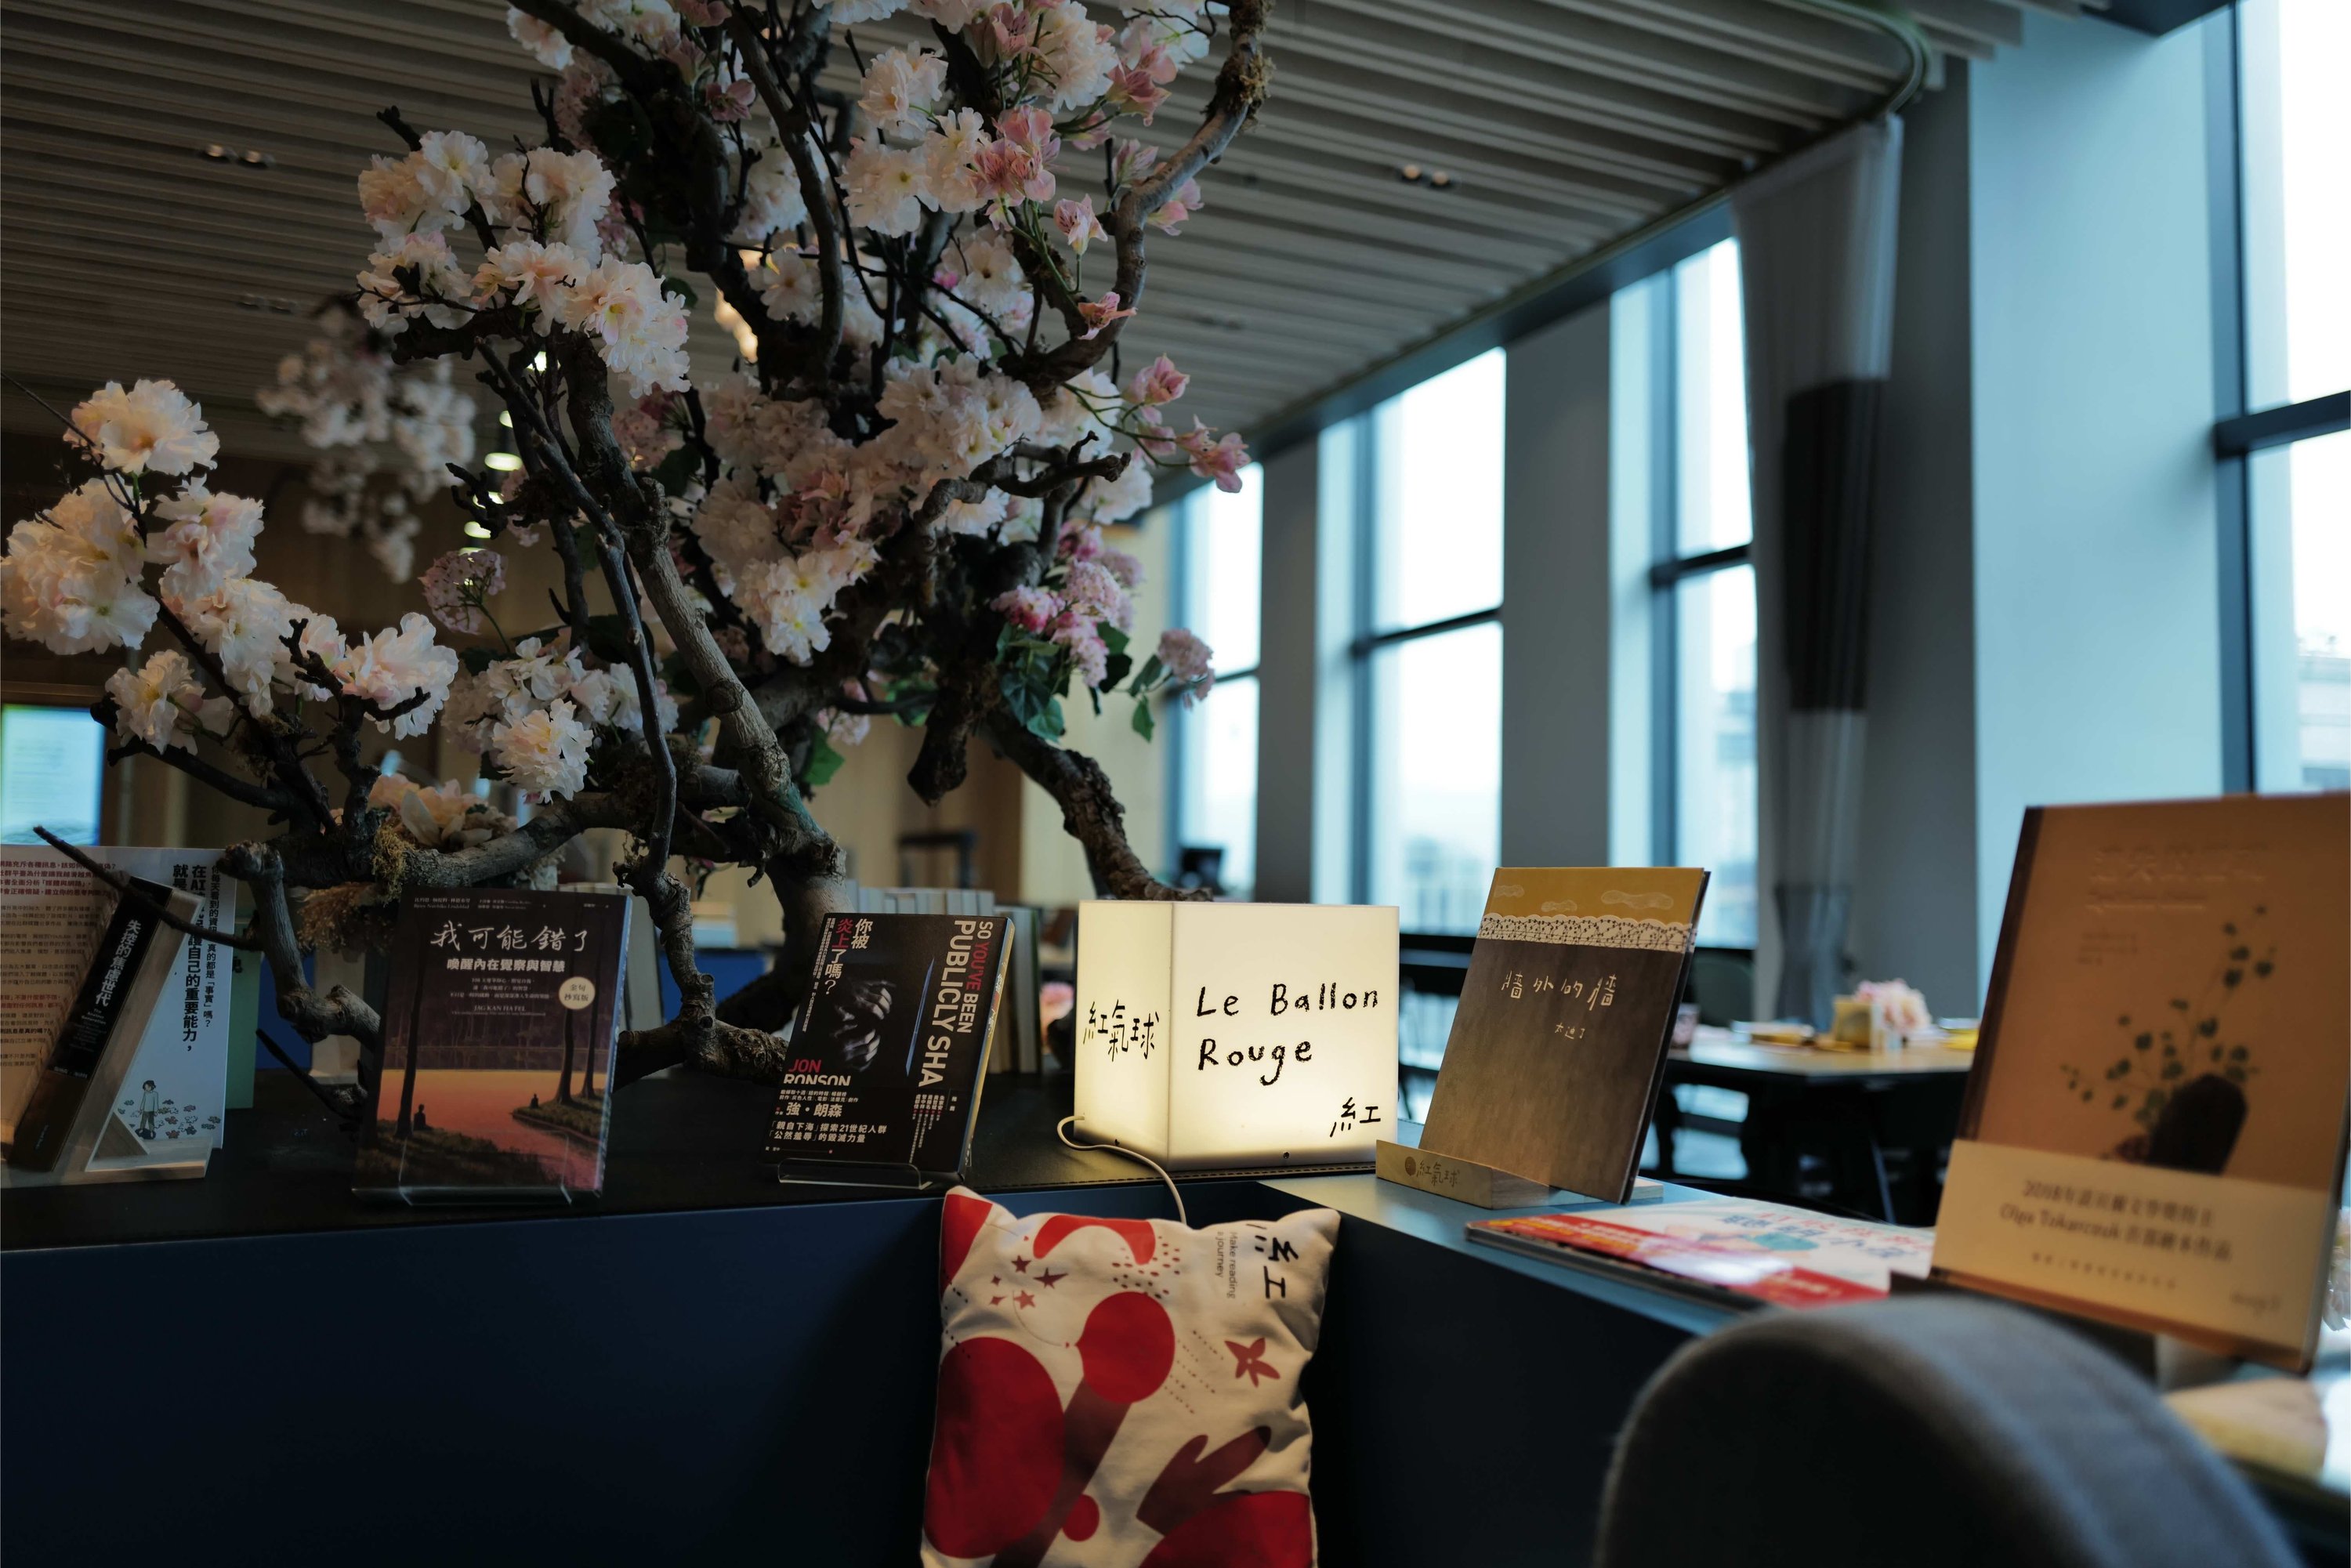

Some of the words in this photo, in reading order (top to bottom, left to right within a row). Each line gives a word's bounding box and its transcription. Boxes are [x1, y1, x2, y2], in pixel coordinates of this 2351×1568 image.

[204, 864, 220, 1027] 你每天看到的資訊真的都是「事實」嗎？
[430, 920, 588, 951] 我可能錯了
[850, 918, 874, 949] 你被
[977, 921, 994, 940] SO
[95, 919, 142, 1008] 失控的焦慮世代
[447, 958, 565, 972] 喚醒內在覺察與智慧
[932, 920, 976, 1032] PUBLICLY
[965, 941, 991, 991] YOU'VE
[1197, 987, 1239, 1017] Le
[1271, 982, 1378, 1016] Ballon
[1501, 970, 1617, 1012] 牆外的牆
[957, 993, 979, 1034] BEEN
[1083, 999, 1160, 1063] 紅氣球
[783, 1074, 851, 1086] RONSON
[788, 1059, 822, 1073] JON
[918, 1035, 951, 1088] SHA
[1197, 1038, 1313, 1086] Rouge
[1330, 1097, 1381, 1138] 紅
[1416, 1160, 1461, 1187] 紅氣球
[1215, 1237, 1224, 1278] journey
[1226, 1259, 1238, 1298] reading
